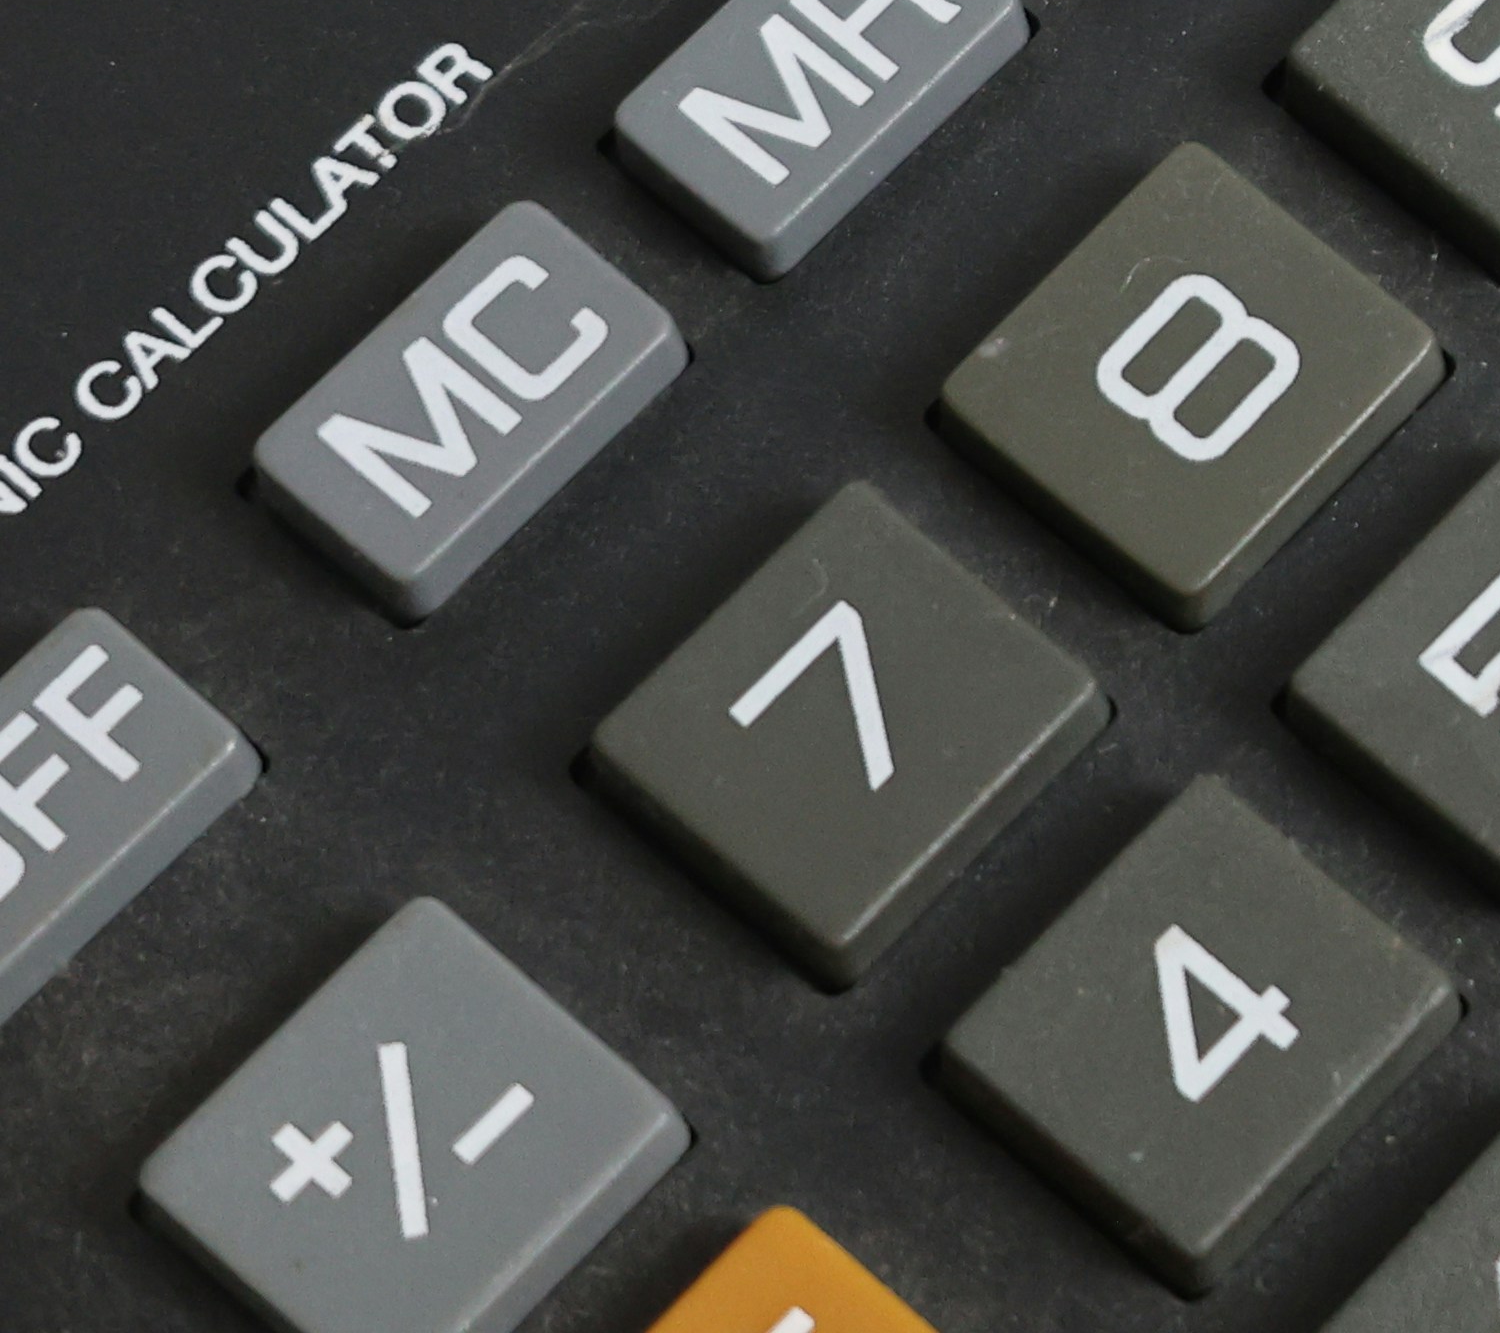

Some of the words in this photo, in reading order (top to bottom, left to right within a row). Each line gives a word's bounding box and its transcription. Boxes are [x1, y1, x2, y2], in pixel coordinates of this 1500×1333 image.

[76, 41, 494, 421] CALCULATOR
[317, 255, 609, 518] MC
[1096, 273, 1300, 462] 8
[0, 644, 143, 901] FF
[729, 600, 894, 790] 7
[1155, 925, 1299, 1101] 4
[270, 1042, 534, 1239] +/-
